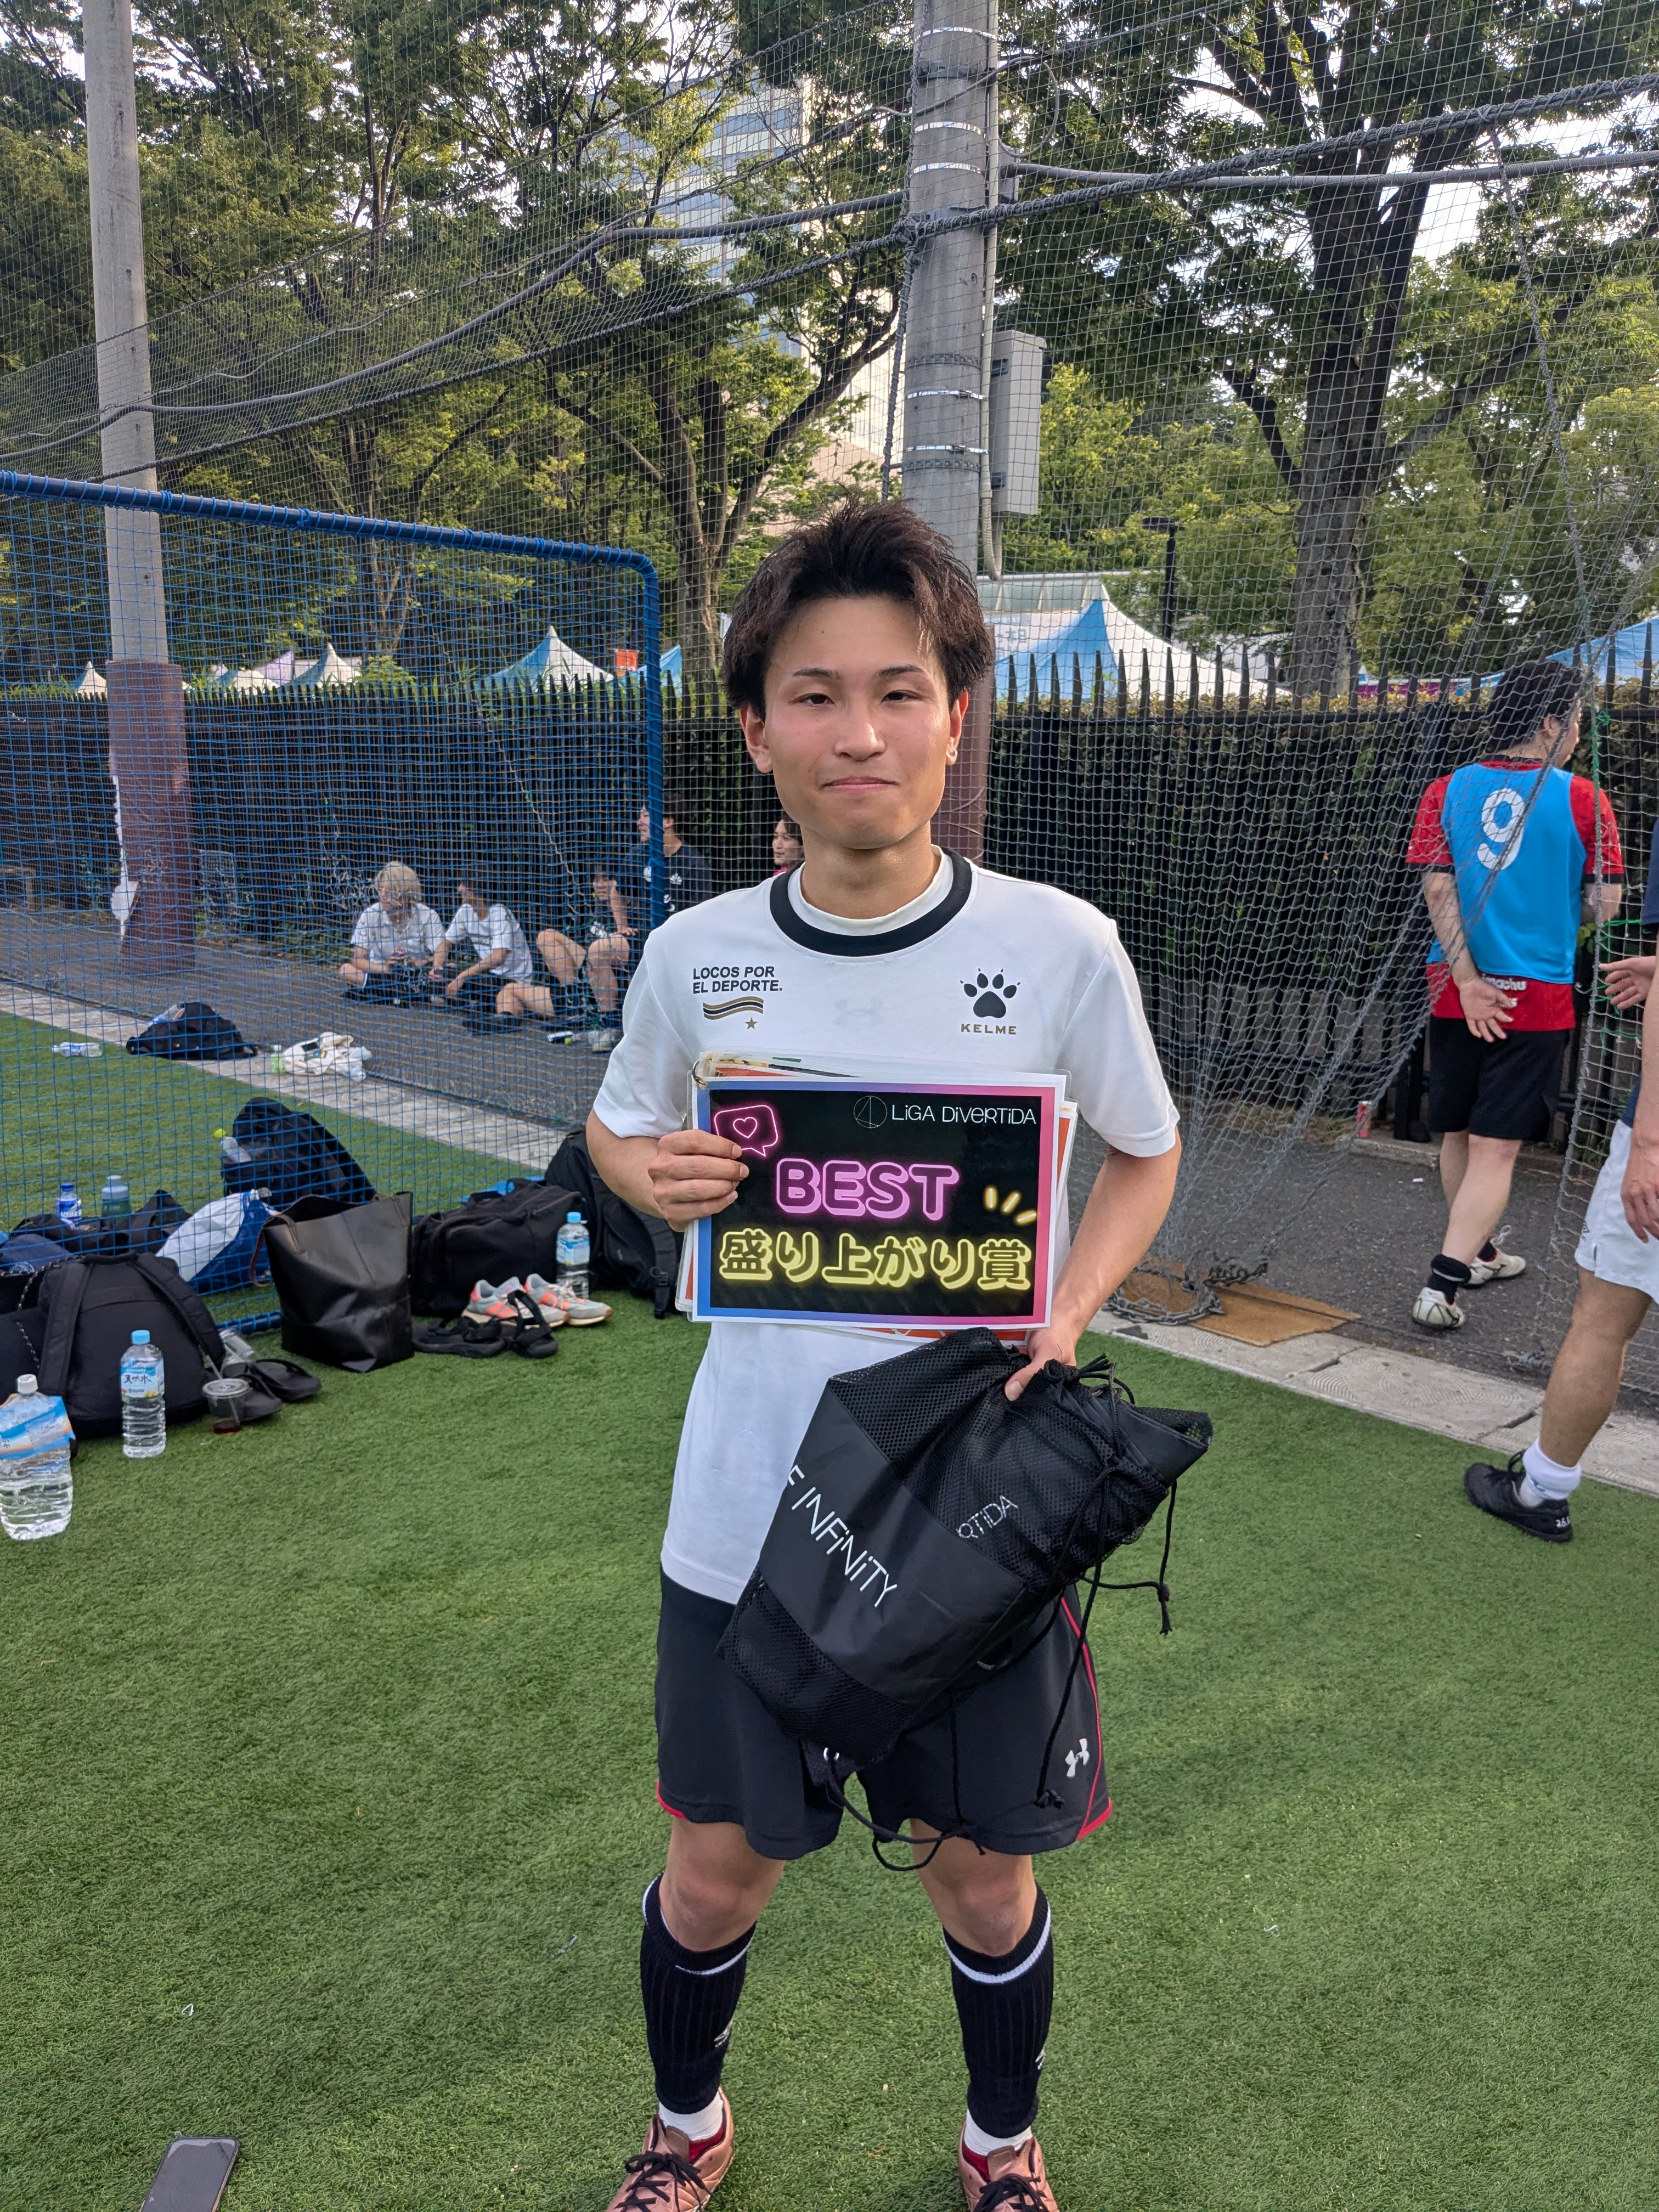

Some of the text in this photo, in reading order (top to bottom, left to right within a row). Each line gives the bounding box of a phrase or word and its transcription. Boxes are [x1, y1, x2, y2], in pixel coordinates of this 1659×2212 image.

[1476, 788, 1525, 870] 9
[693, 966, 775, 980] LOCOS POR
[693, 980, 783, 994] EL DEPORTE.
[961, 1024, 1017, 1035] KELME
[775, 1158, 960, 1220] BEST
[719, 1228, 1031, 1291] 盛り上がり賞
